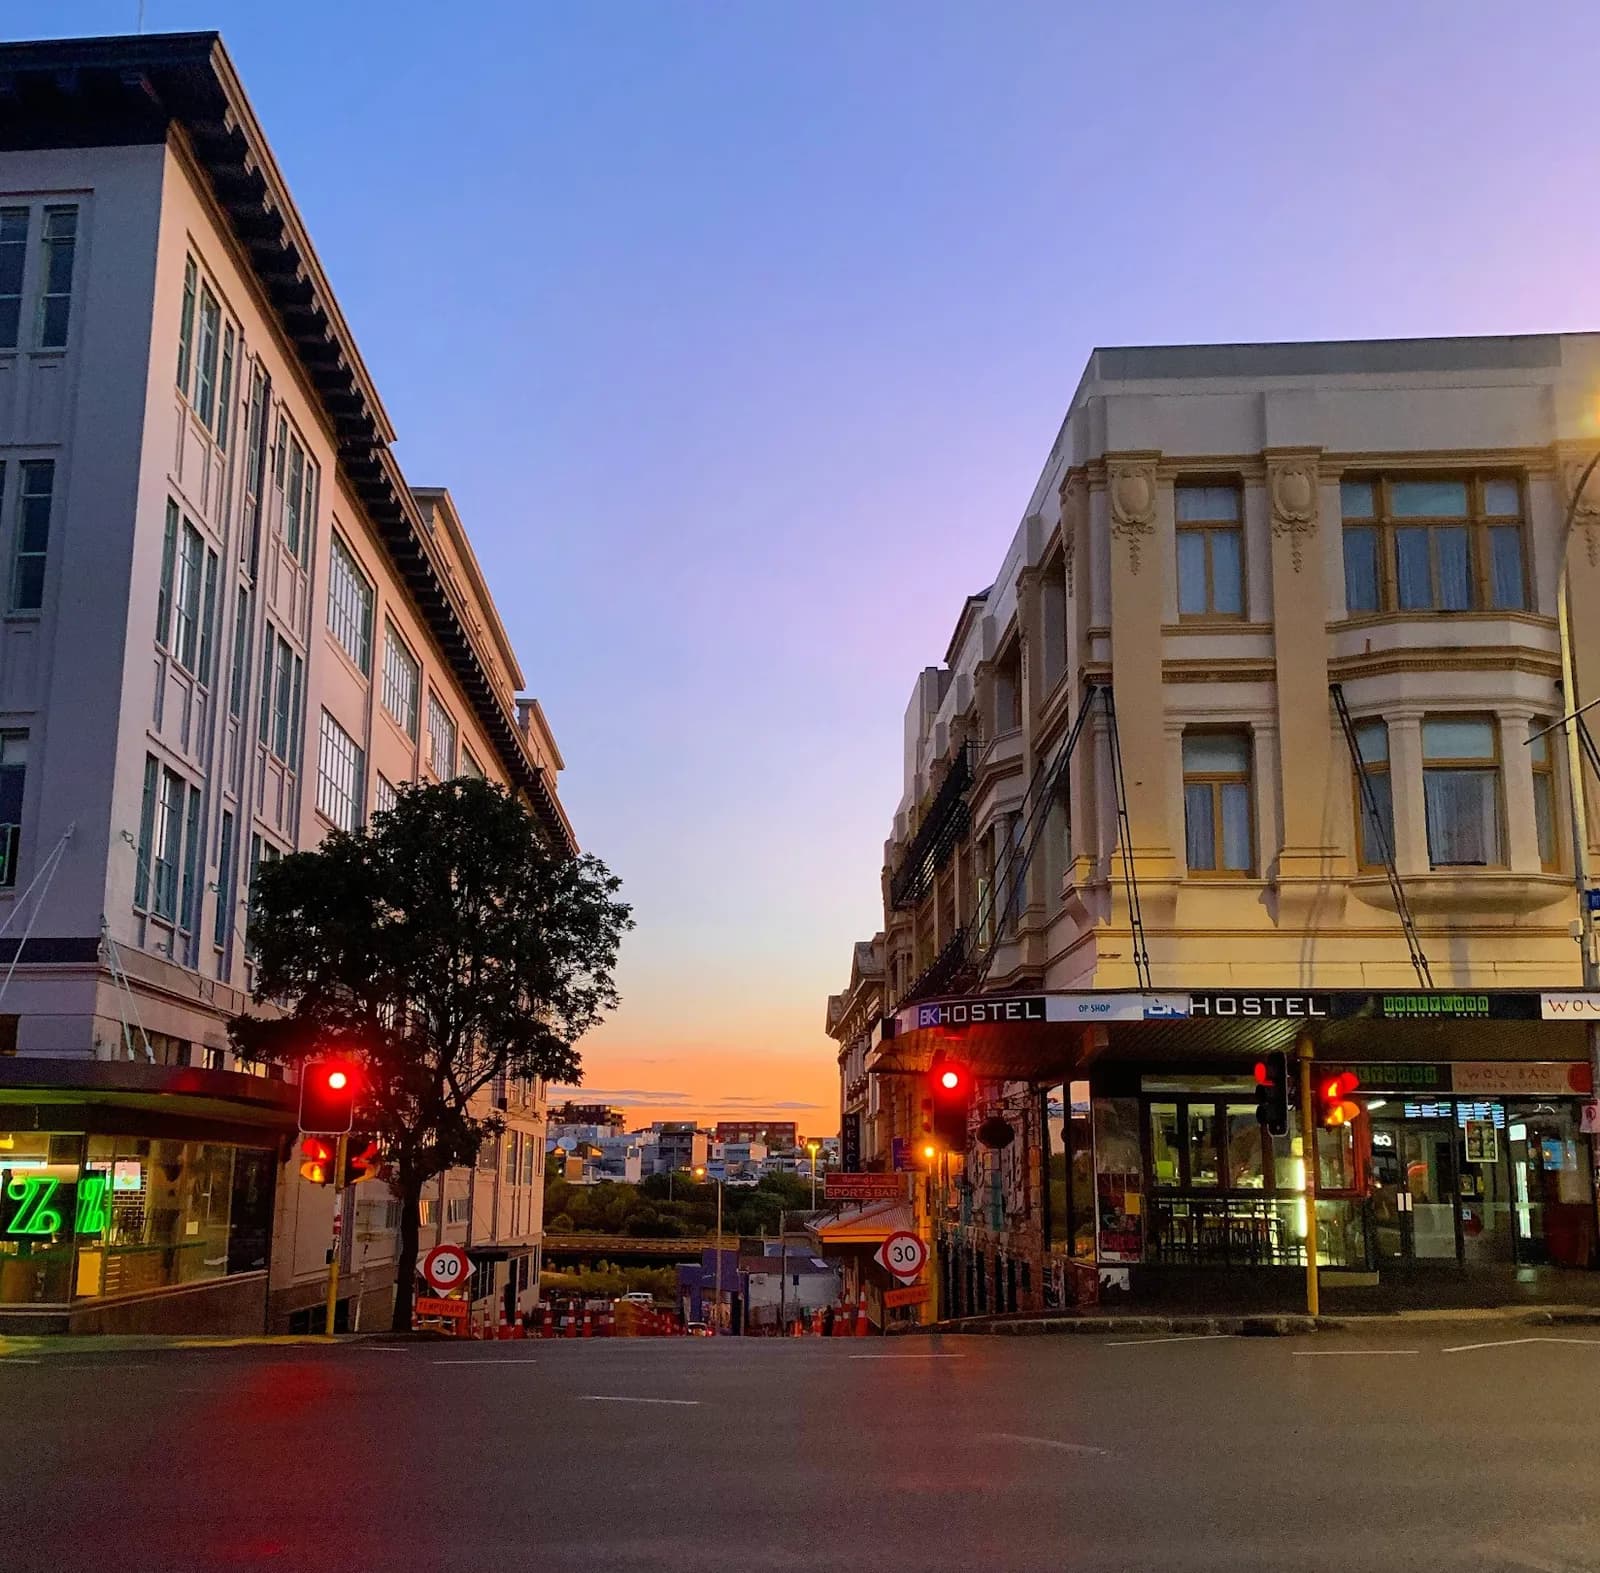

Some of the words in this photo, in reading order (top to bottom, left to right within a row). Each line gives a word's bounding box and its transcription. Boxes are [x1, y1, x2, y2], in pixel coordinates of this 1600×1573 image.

[938, 1001, 1042, 1024] HOSTEL
[1078, 1004, 1089, 1013] OP
[1090, 1003, 1111, 1013] SHOP
[1189, 996, 1327, 1016] HOSTEL
[827, 1187, 872, 1198] SPORTS
[874, 1187, 898, 1198] BAR
[893, 1245, 916, 1263] 30
[435, 1259, 458, 1276] 30
